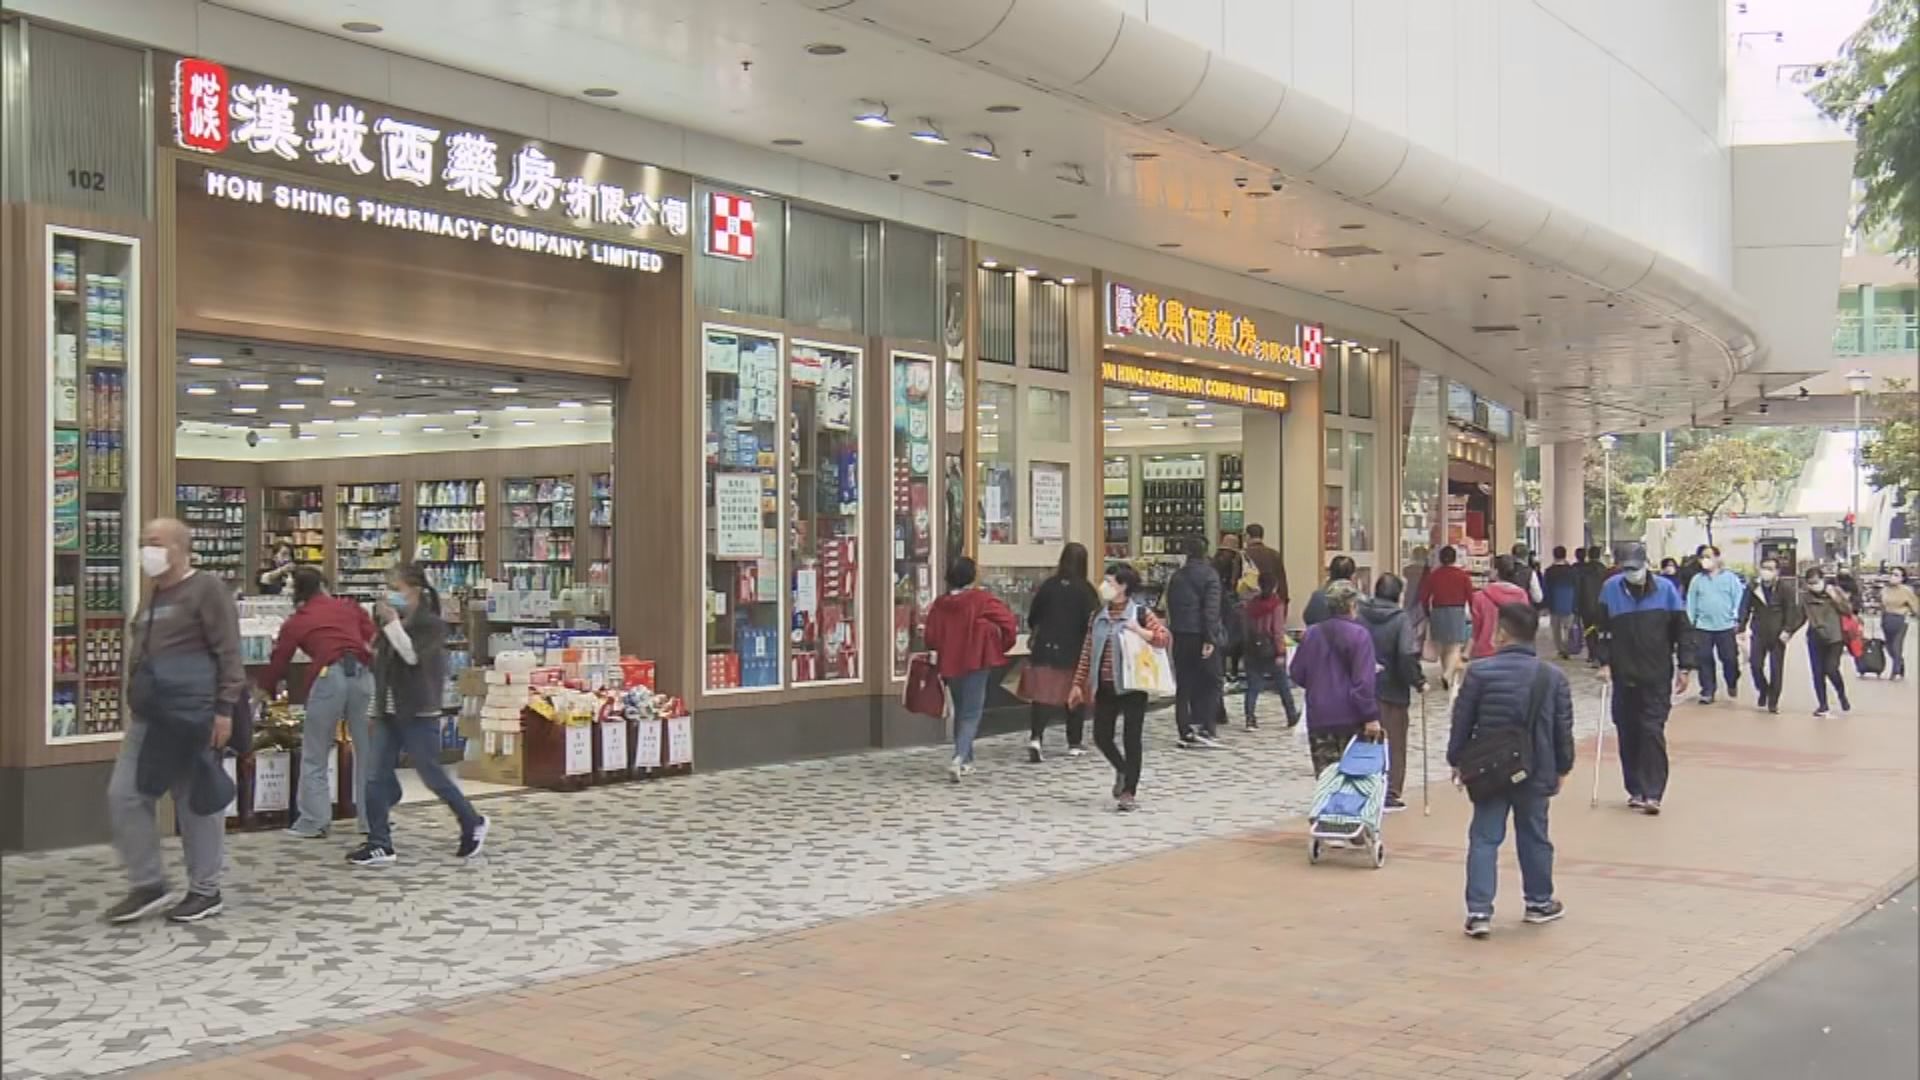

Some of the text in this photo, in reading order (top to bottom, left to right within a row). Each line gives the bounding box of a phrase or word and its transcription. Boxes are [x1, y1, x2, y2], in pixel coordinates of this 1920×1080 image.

[68, 168, 105, 192] 102
[230, 83, 687, 236] 漢城西藥房有限公司
[207, 171, 663, 273] HON SHING PHARMACY COMPANY LIMITED
[1205, 380, 1251, 403] COMPANY
[1251, 388, 1286, 408] LIMITED
